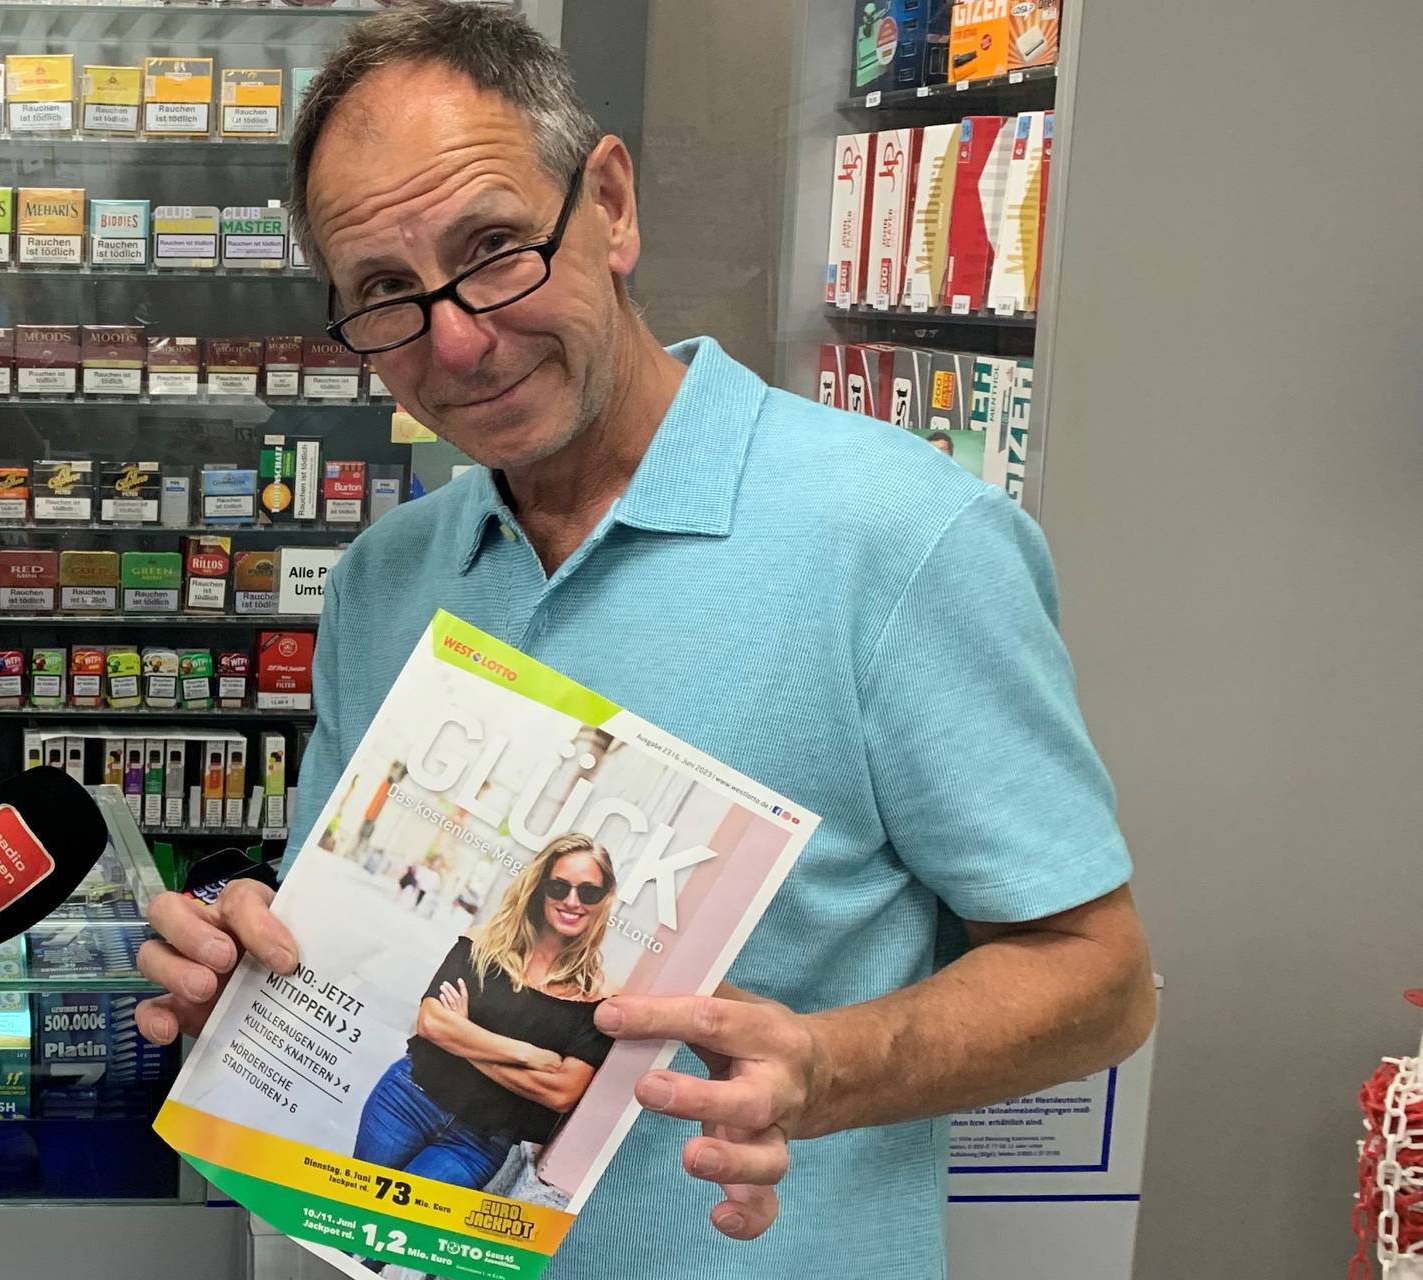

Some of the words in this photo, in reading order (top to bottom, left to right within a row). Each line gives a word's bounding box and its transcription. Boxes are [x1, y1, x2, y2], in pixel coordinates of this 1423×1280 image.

[33, 113, 62, 121] tödlich
[158, 105, 195, 113] Rauchen
[169, 114, 198, 123] tödlich
[26, 201, 78, 218] MEHARI'S
[223, 207, 261, 219] CLUB
[914, 155, 946, 275] Marlboro
[1004, 147, 1043, 275] Marlboro
[101, 214, 138, 229] BIDDIES
[222, 221, 282, 234] MASTER
[27, 237, 71, 247] Rauchen
[98, 240, 138, 249] Rauchen
[26, 248, 39, 256] ist
[40, 247, 75, 257] tödlich
[109, 249, 142, 258] tödlich
[24, 332, 72, 342] MOODS
[90, 332, 137, 343] MOODS
[311, 344, 349, 353] MOOD
[989, 365, 1001, 422] MENTHOL
[334, 482, 362, 492] Burton
[297, 482, 306, 516] Rauchen
[10, 565, 45, 574] RED
[131, 567, 173, 576] GREEN
[289, 566, 314, 578] Alle
[192, 580, 223, 588] Rauchen
[295, 584, 324, 596] Umt
[135, 590, 169, 598] Rauchen
[144, 598, 169, 606] tödlich
[443, 635, 474, 658] WEST
[480, 655, 518, 683] LOTTO
[636, 733, 663, 751] Ausgabe
[694, 764, 712, 779] 2023
[406, 717, 719, 931] GLÜCK
[386, 782, 411, 806] Das
[415, 798, 491, 854] kostenlose
[492, 846, 534, 879] Maga
[605, 914, 665, 955] stLotto
[293, 962, 318, 988] NO:
[318, 982, 365, 1017] JETZT
[266, 971, 337, 1028] MITTIPPEN
[352, 1028, 363, 1044] 3
[44, 1013, 106, 1032] 500.000€
[251, 1000, 317, 1052] KULLERAUGEN
[316, 1045, 338, 1067] UND
[44, 1041, 107, 1058] Platin
[244, 1015, 285, 1049] KULTIGES
[284, 1044, 334, 1084] KNATTERN
[341, 1083, 351, 1094] 4
[230, 1039, 294, 1092] MÖRDERISCHE
[222, 1053, 281, 1104] STADTTOUREN
[288, 1103, 298, 1114] 6
[988, 1107, 1072, 1115] Teilnahmebedingungen
[329, 1174, 358, 1190] Jackpot
[359, 1183, 370, 1192] rd.
[353, 1170, 371, 1183] Juni
[375, 1175, 412, 1206] 73
[414, 1198, 431, 1209] Mio.
[432, 1202, 451, 1214] Euro
[480, 1198, 522, 1220] EURO
[302, 1207, 336, 1224] 10./11.
[336, 1218, 357, 1230] Juni
[464, 1210, 535, 1240] JACKPOT
[302, 1219, 340, 1237] Jackpot
[341, 1230, 355, 1241] rd.
[361, 1222, 408, 1256] 1,2
[407, 1248, 429, 1261] Mio.
[430, 1253, 453, 1267] Euro
[438, 1237, 483, 1261] TOTO
